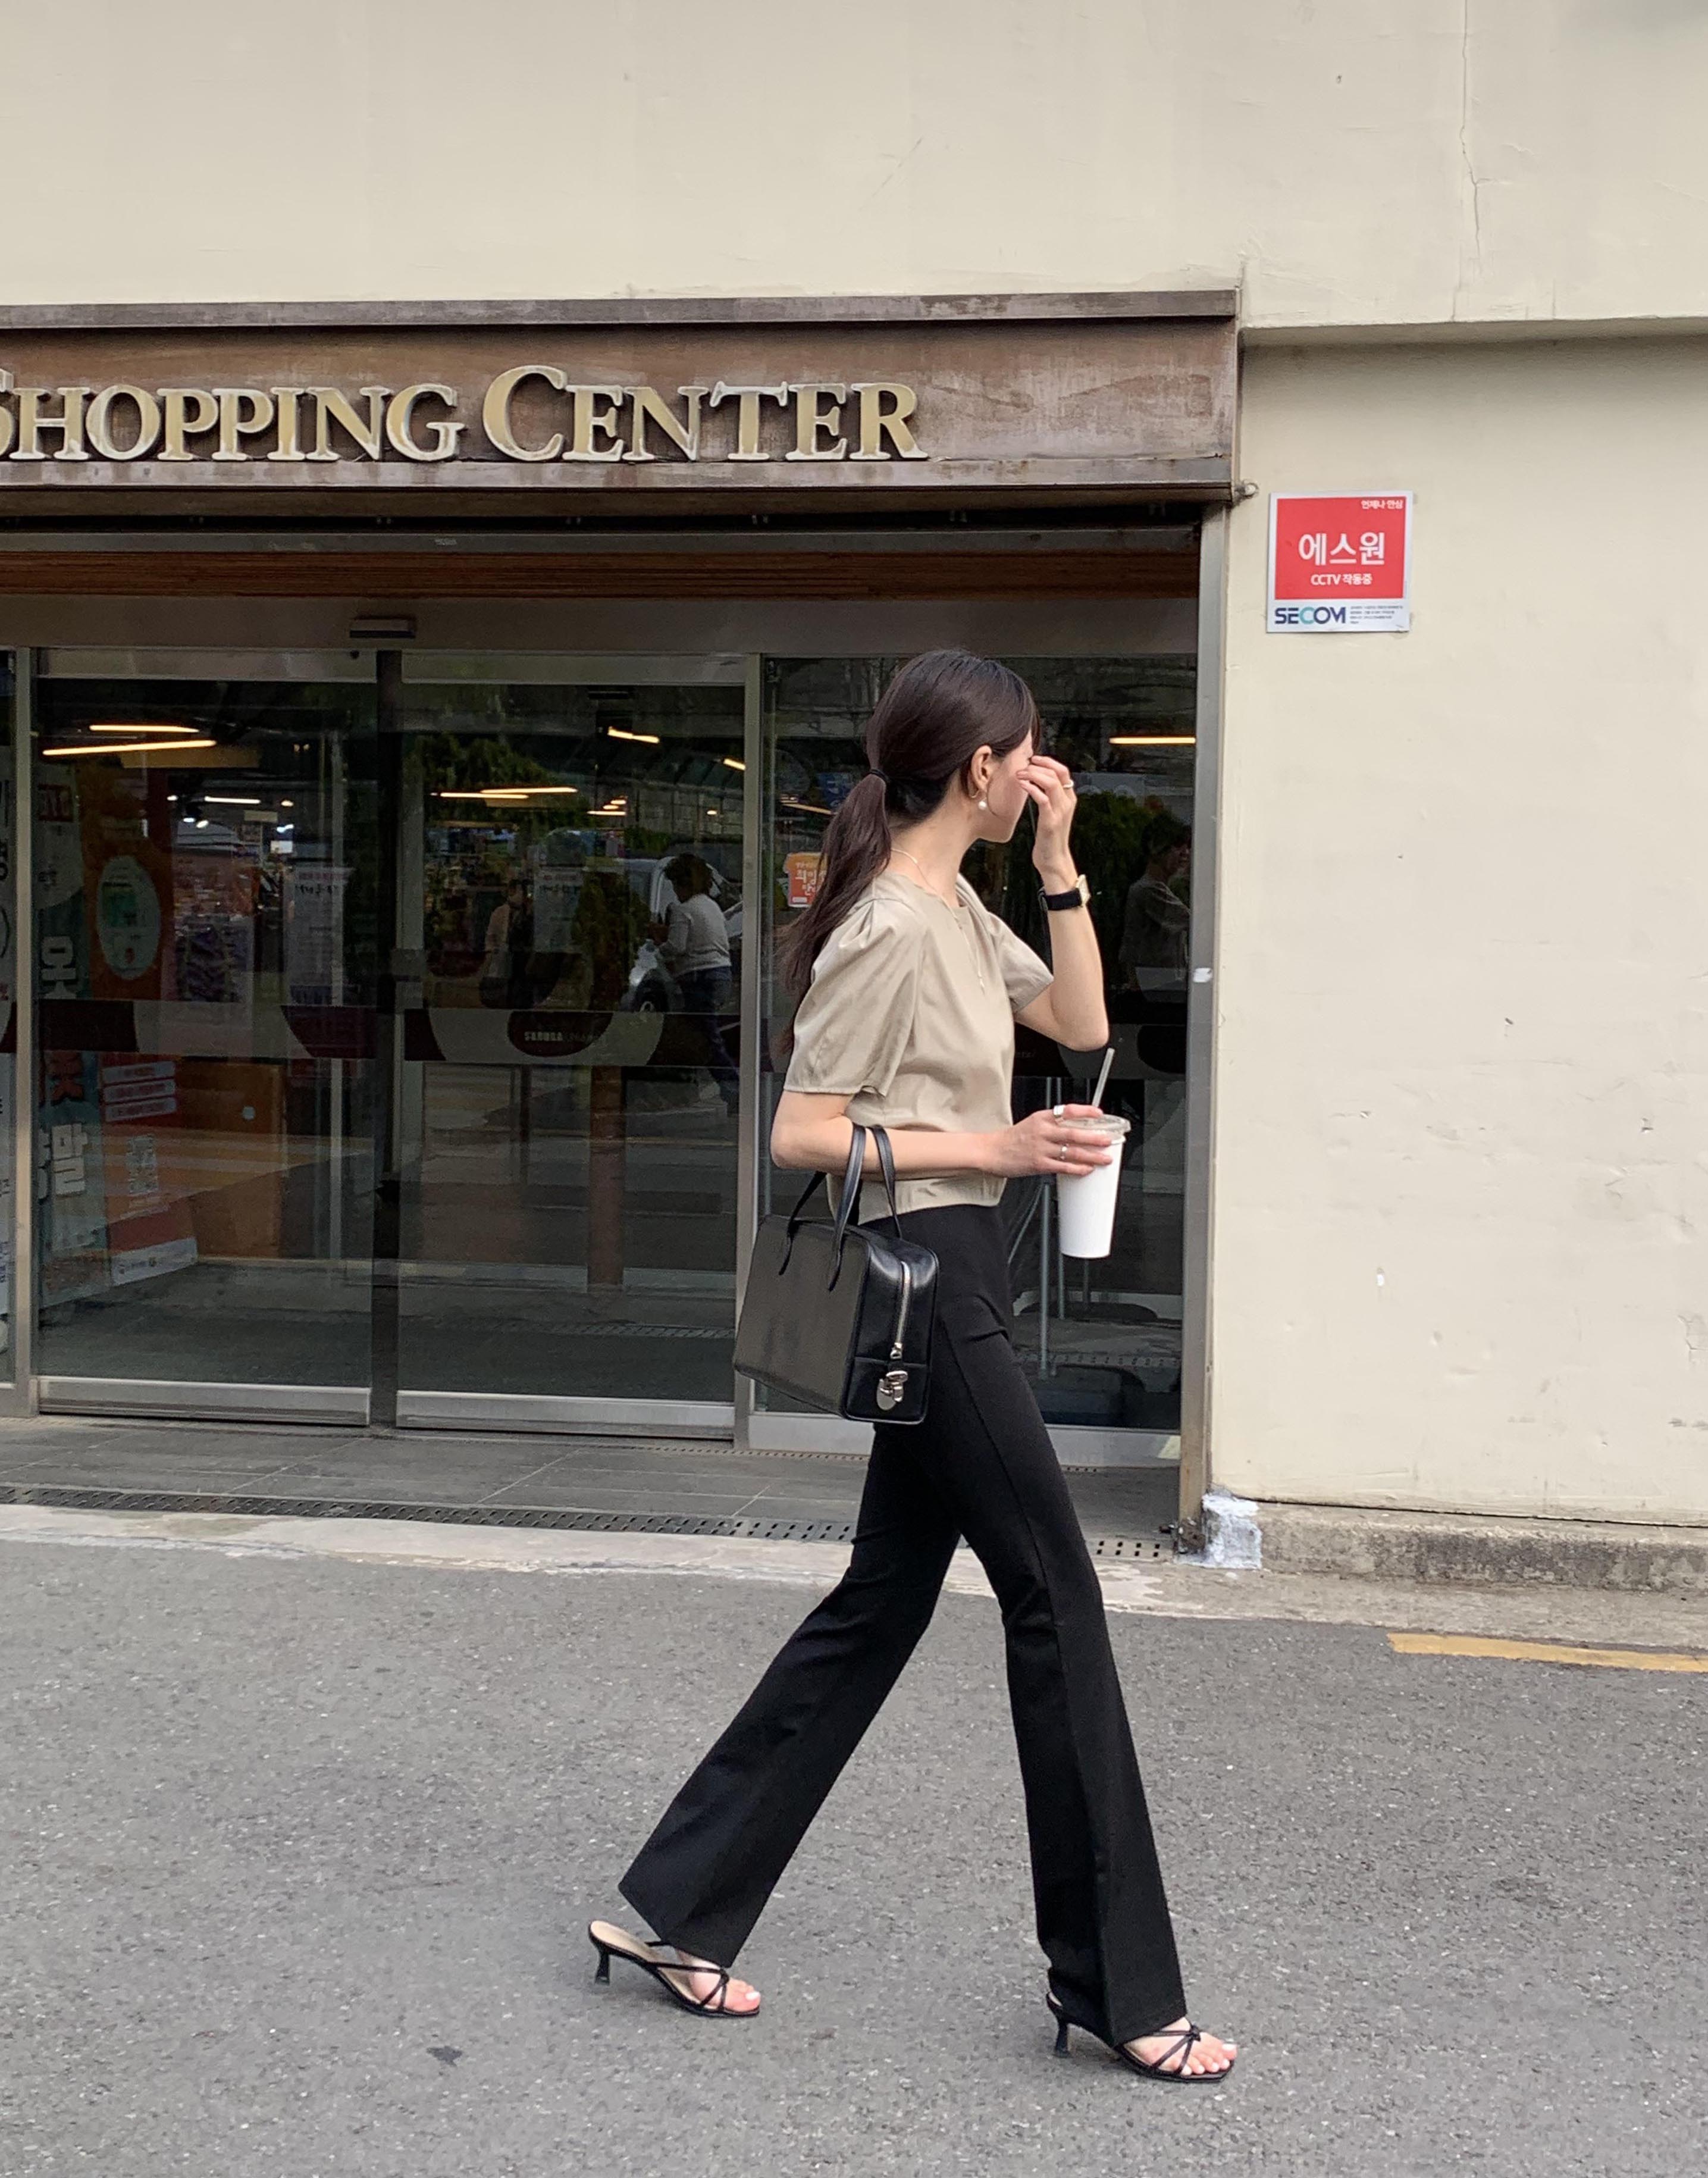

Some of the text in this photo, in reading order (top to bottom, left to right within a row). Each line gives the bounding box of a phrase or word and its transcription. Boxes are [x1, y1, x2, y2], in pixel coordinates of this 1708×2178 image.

[0, 365, 928, 461] HOPPING CENTER
[1299, 532, 1384, 565] 에스원
[1311, 574, 1372, 585] CCTV 작동중
[1275, 606, 1346, 624] SECOM
